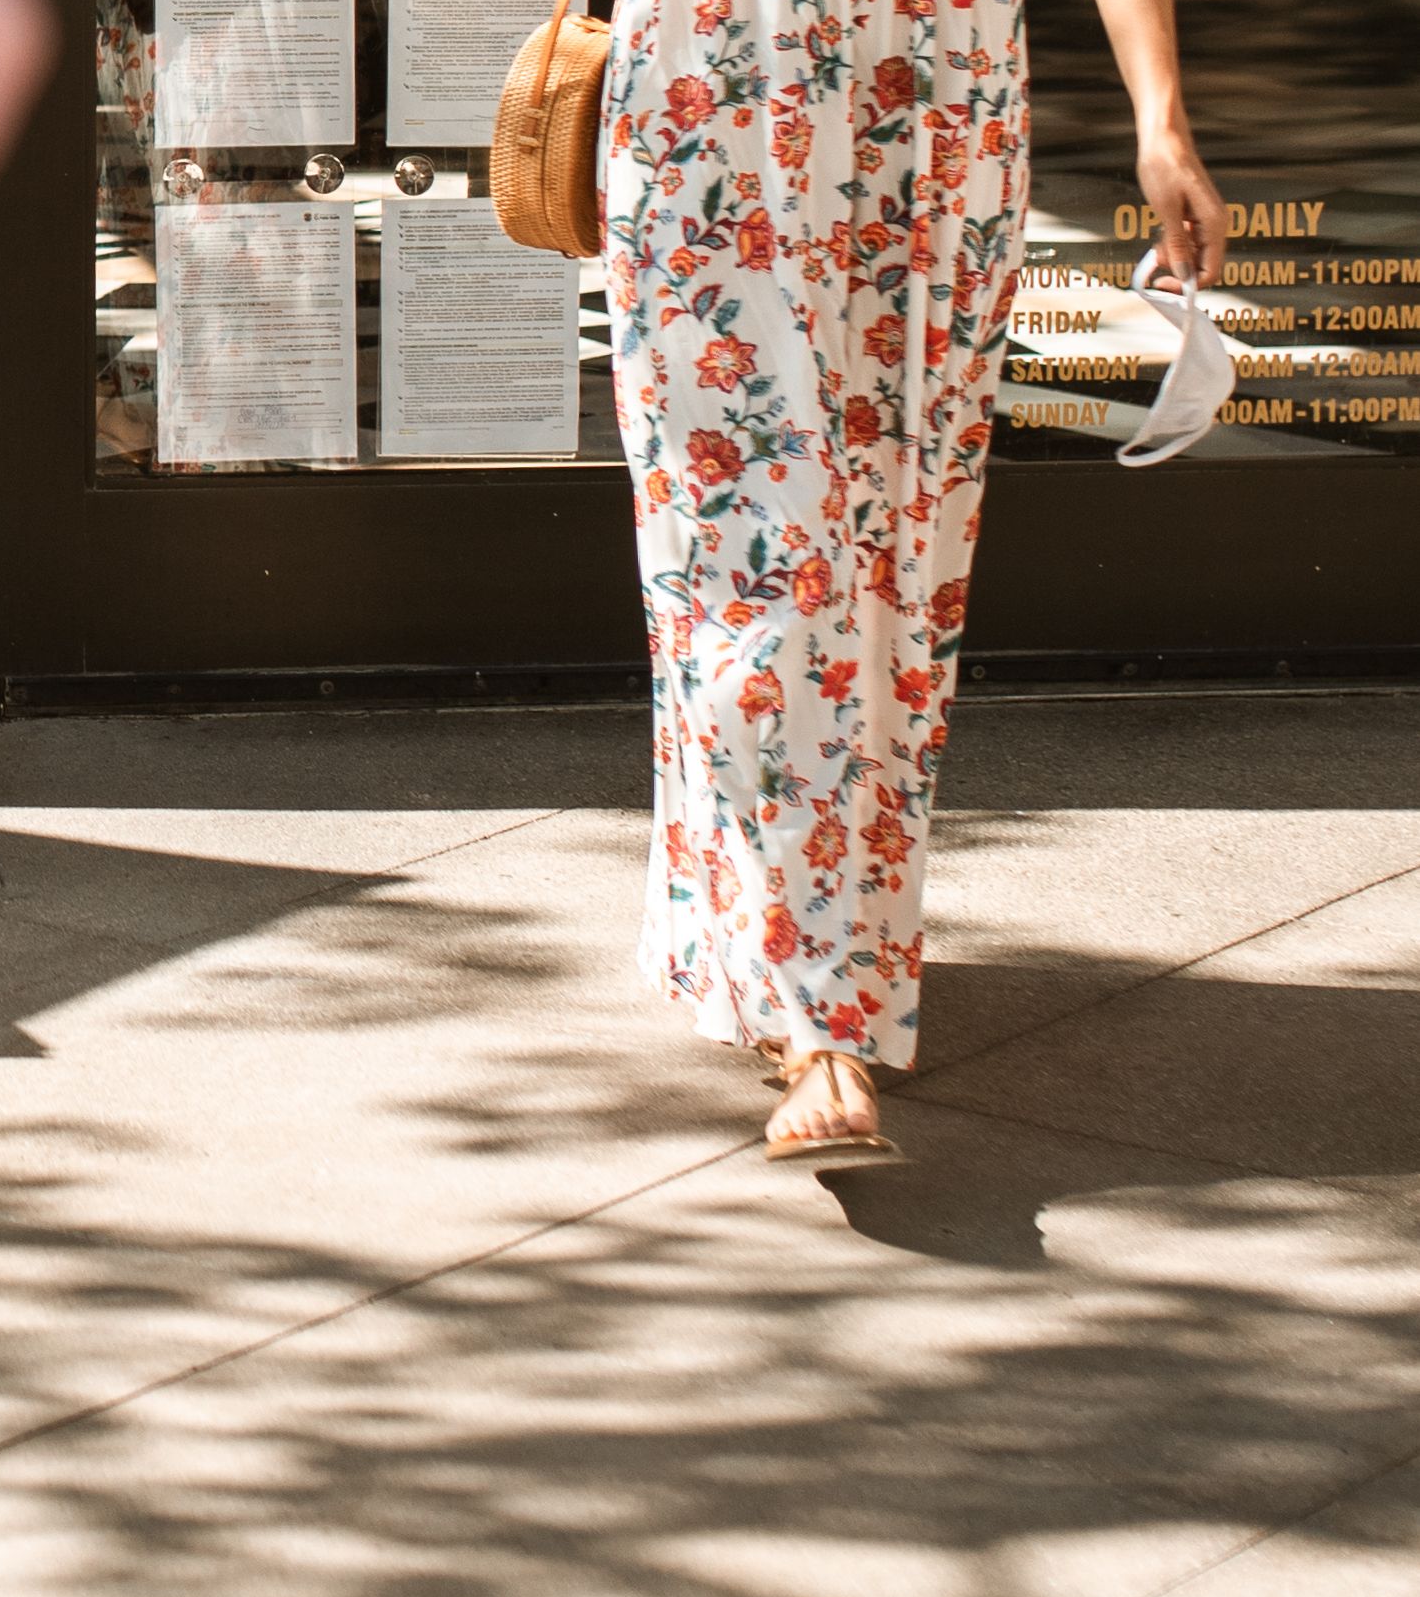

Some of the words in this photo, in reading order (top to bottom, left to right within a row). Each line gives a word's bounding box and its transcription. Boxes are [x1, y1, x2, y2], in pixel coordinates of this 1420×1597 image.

[1114, 204, 1162, 240] OP
[1225, 201, 1325, 240] DAILY
[1013, 311, 1102, 337] FRIDAY
[1011, 356, 1141, 385] SATURDAY
[1010, 402, 1110, 432] SUNDAY
